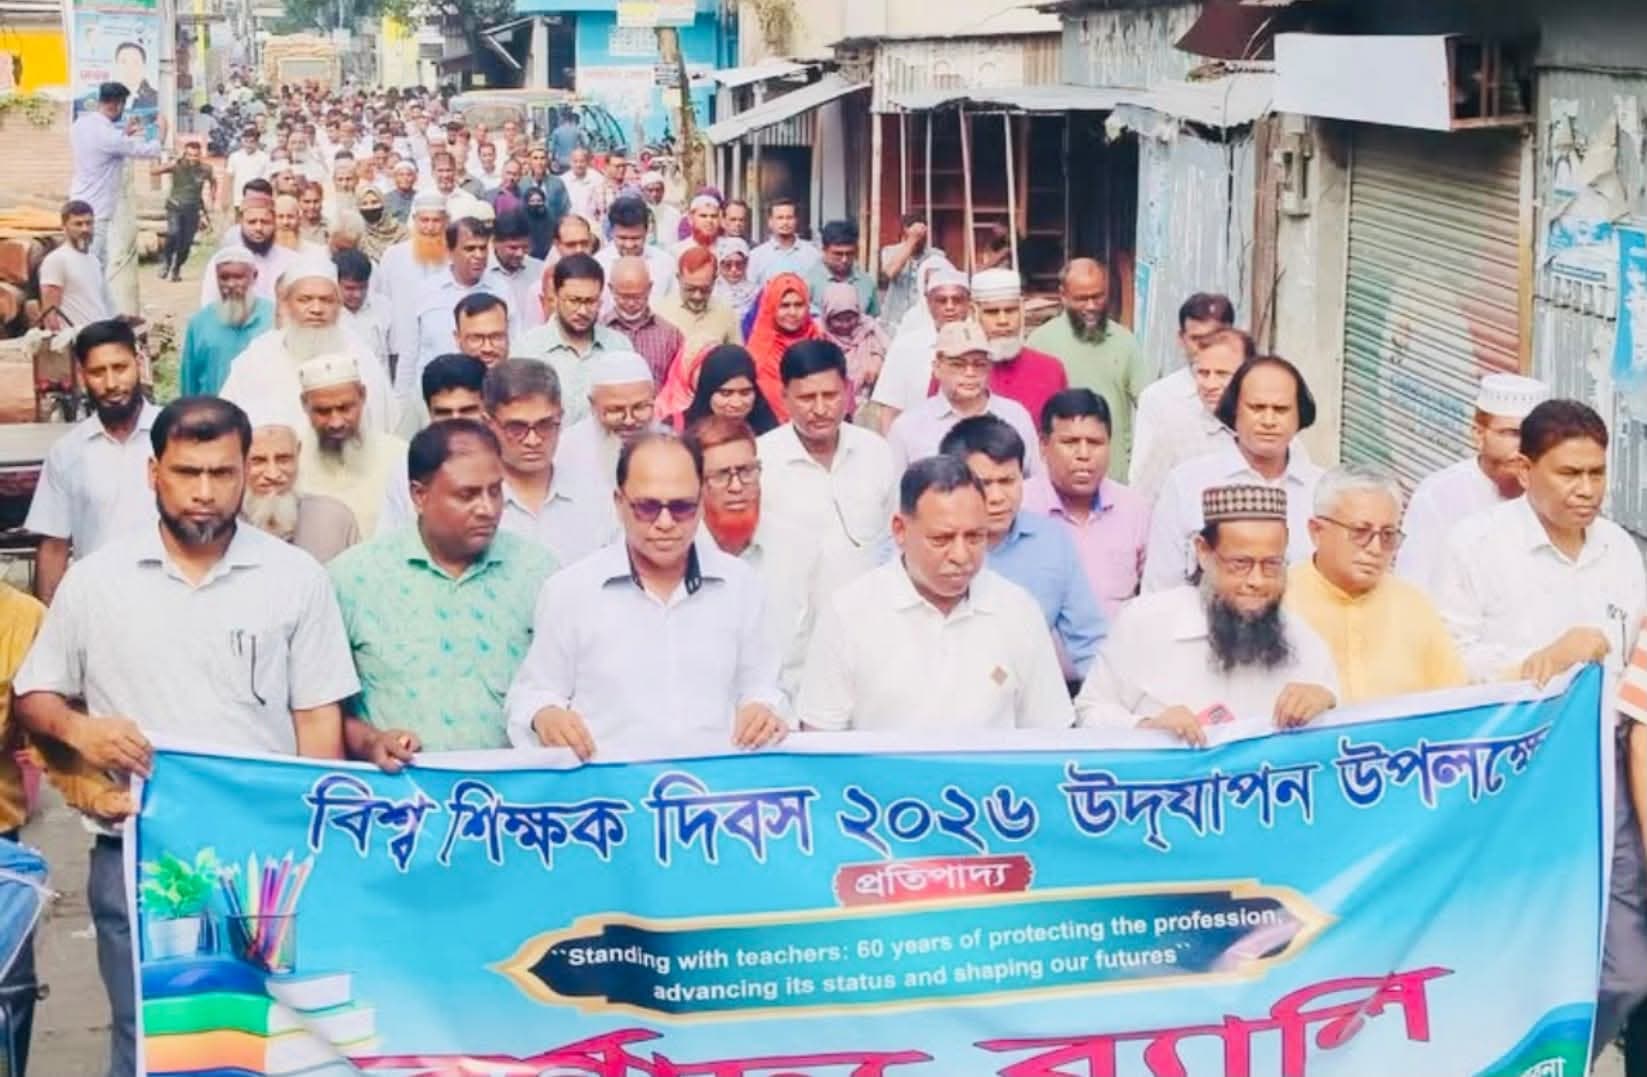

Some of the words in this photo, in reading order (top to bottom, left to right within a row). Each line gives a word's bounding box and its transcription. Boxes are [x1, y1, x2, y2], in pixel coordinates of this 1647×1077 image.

[306, 773, 439, 871] বিশ্ব
[438, 780, 631, 868] শিক্ষক
[643, 771, 816, 865] দিবস
[837, 785, 1039, 859] ২০২৬
[855, 863, 1012, 897] প্রতিপাদ্য
[678, 948, 729, 971] with
[737, 943, 849, 968] teachers:
[857, 939, 884, 959] 60
[891, 935, 952, 953] years
[960, 926, 982, 950] of
[988, 920, 1103, 950] protecting
[1111, 914, 1147, 936] the
[653, 978, 778, 1004] advancing
[786, 975, 815, 995] its
[823, 973, 896, 994] status
[904, 965, 946, 987] and
[954, 955, 1043, 984] shaping
[1050, 954, 1089, 974] our
